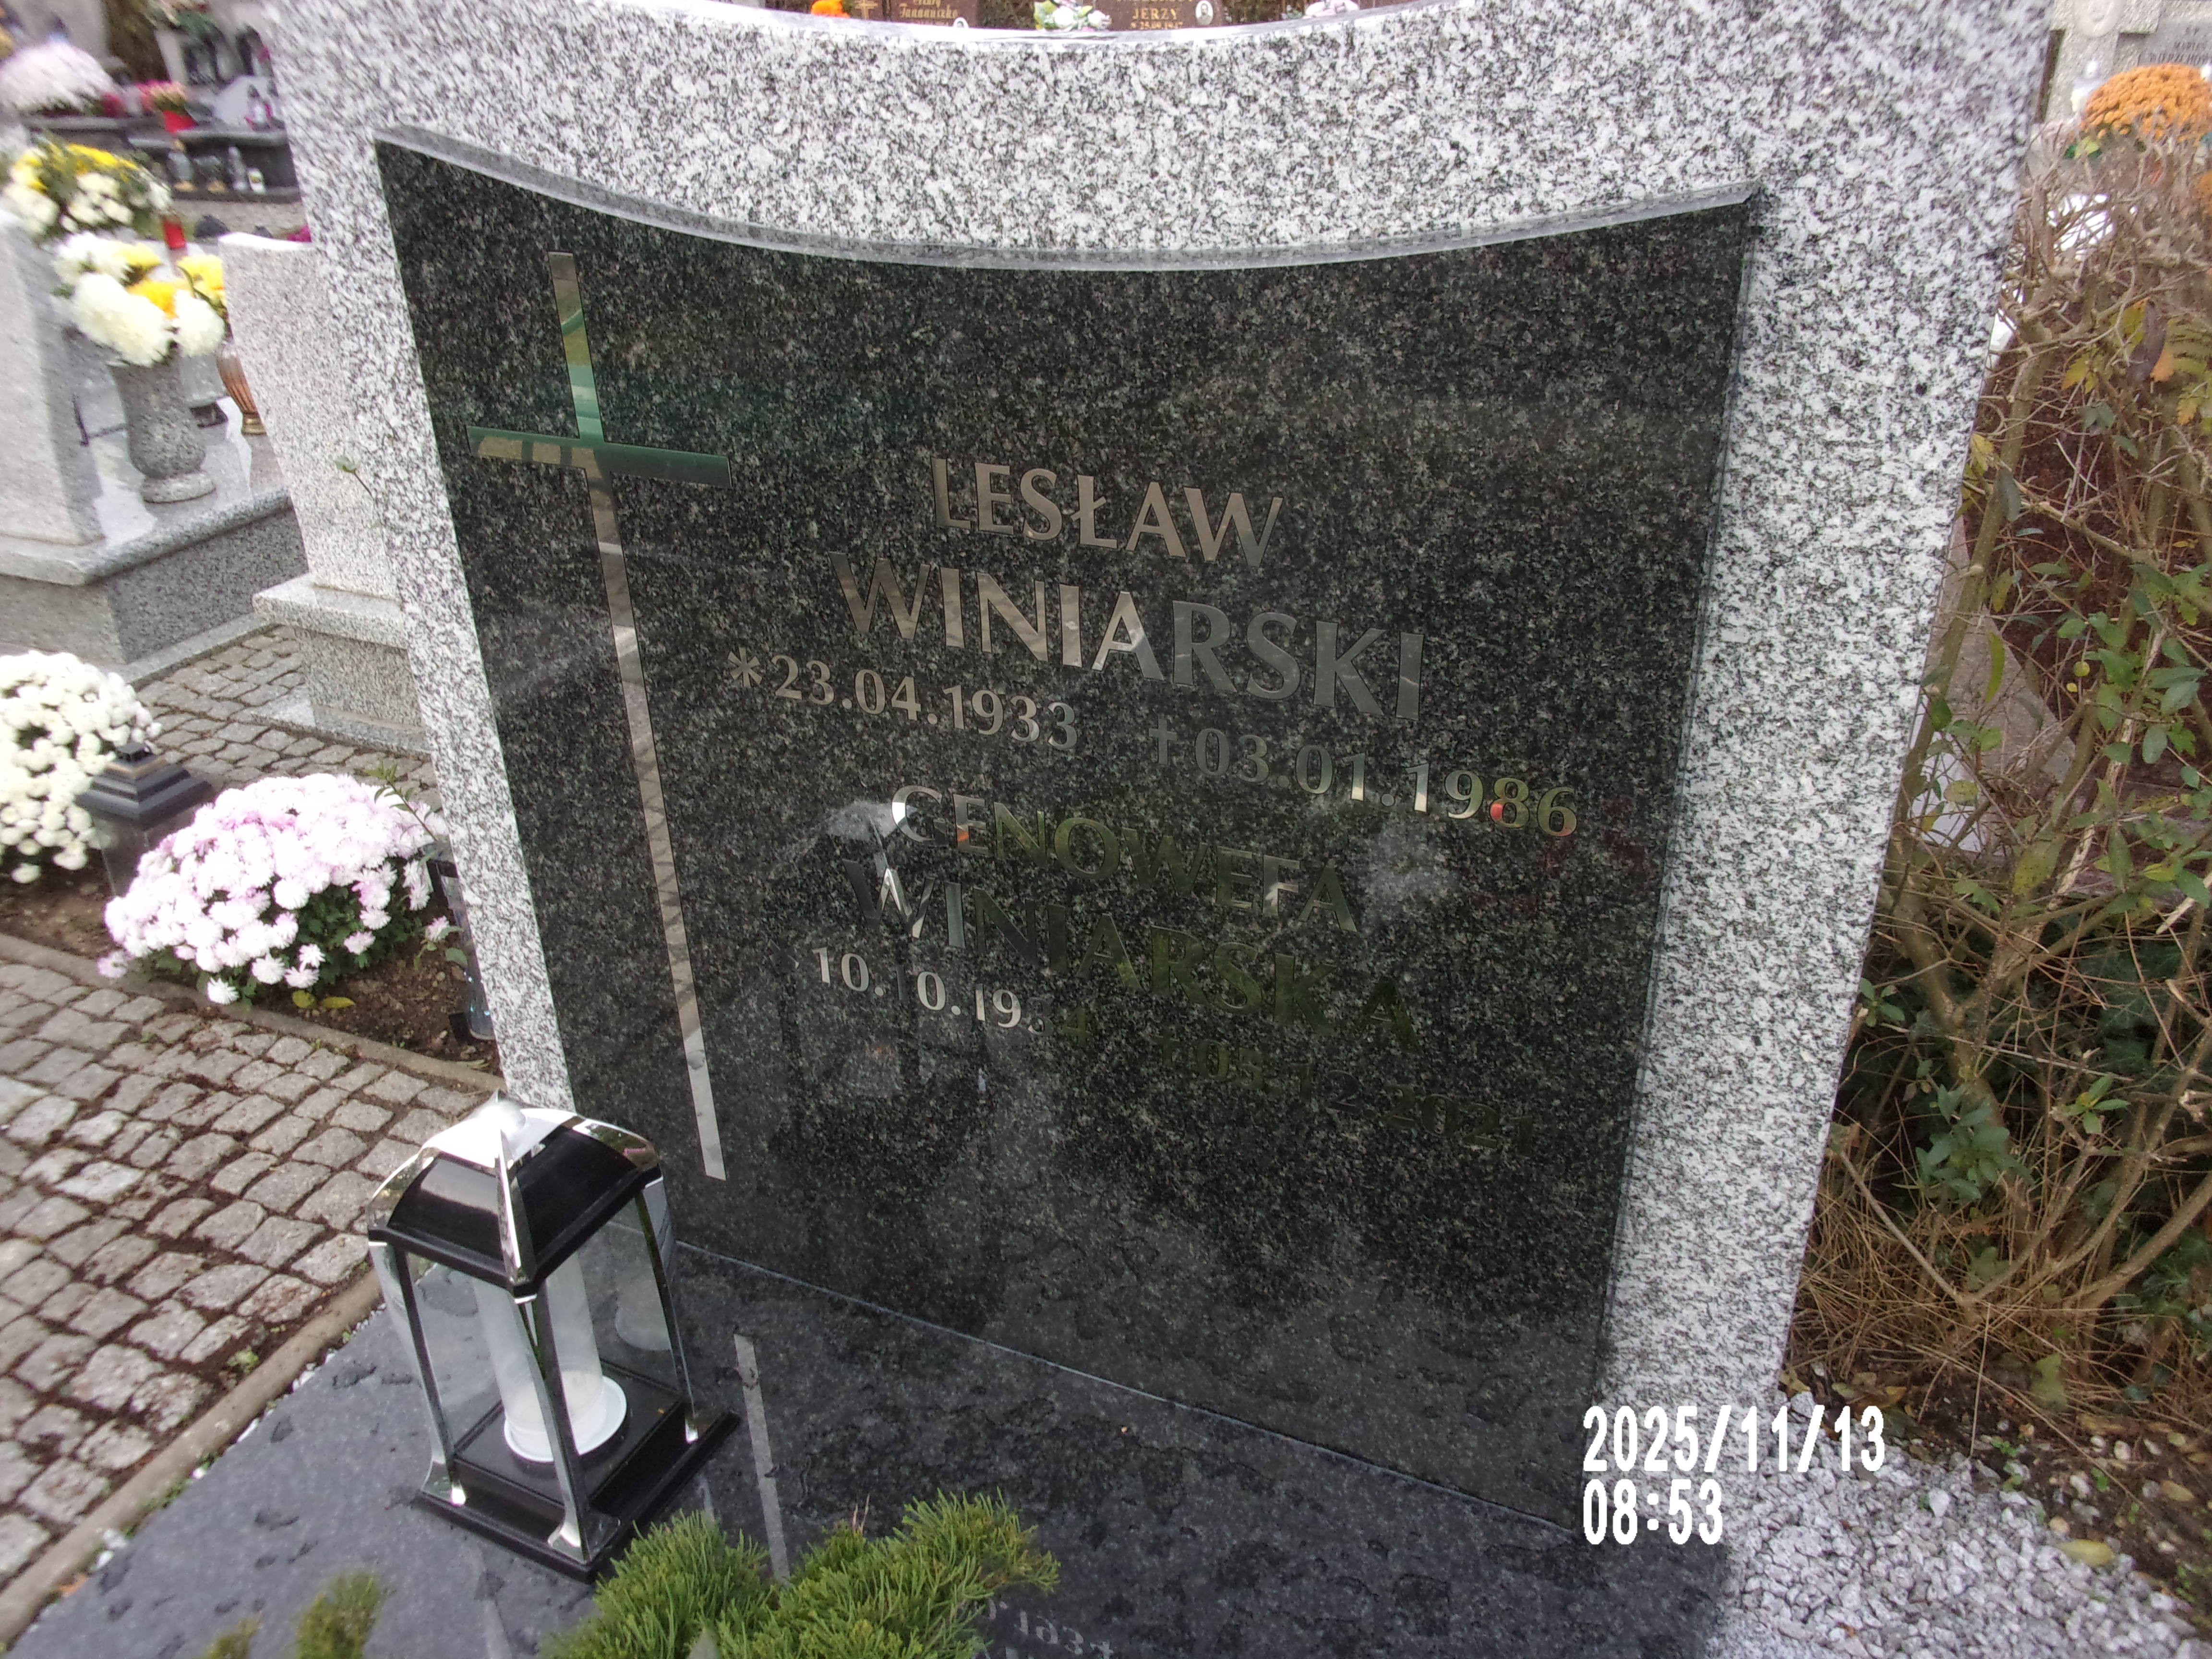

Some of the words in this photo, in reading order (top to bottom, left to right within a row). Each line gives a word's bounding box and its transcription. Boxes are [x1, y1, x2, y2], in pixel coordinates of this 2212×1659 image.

[1132, 8, 1178, 20] JERZY
[931, 457, 1283, 568] LESŁAW
[829, 551, 1425, 720] WINIARSKI
[891, 785, 1358, 933] GENOWEFA
[842, 859, 1425, 1055] WINIARSKA
